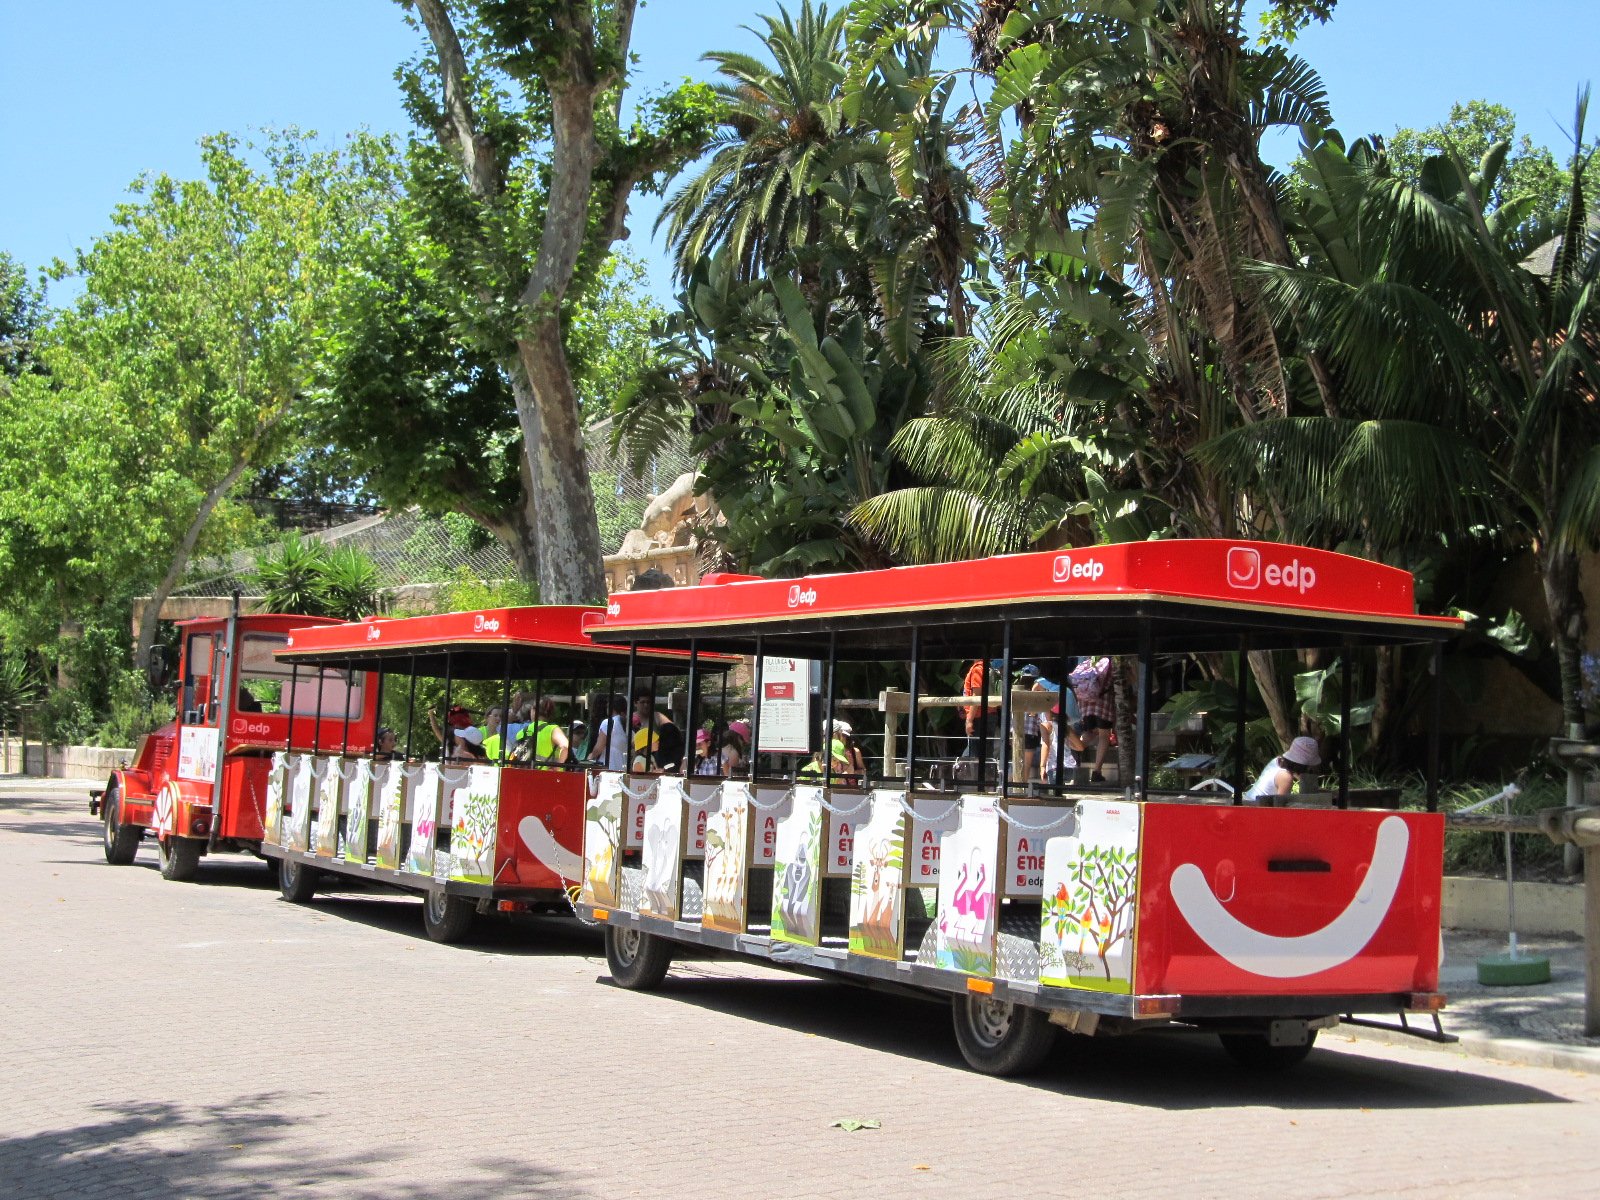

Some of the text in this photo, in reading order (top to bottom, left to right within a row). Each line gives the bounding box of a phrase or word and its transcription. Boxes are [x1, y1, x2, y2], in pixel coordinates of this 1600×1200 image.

[1072, 557, 1104, 581] edp
[1264, 559, 1316, 594] edp
[799, 588, 817, 606] edp
[483, 617, 499, 632] edp
[248, 722, 270, 735] edp
